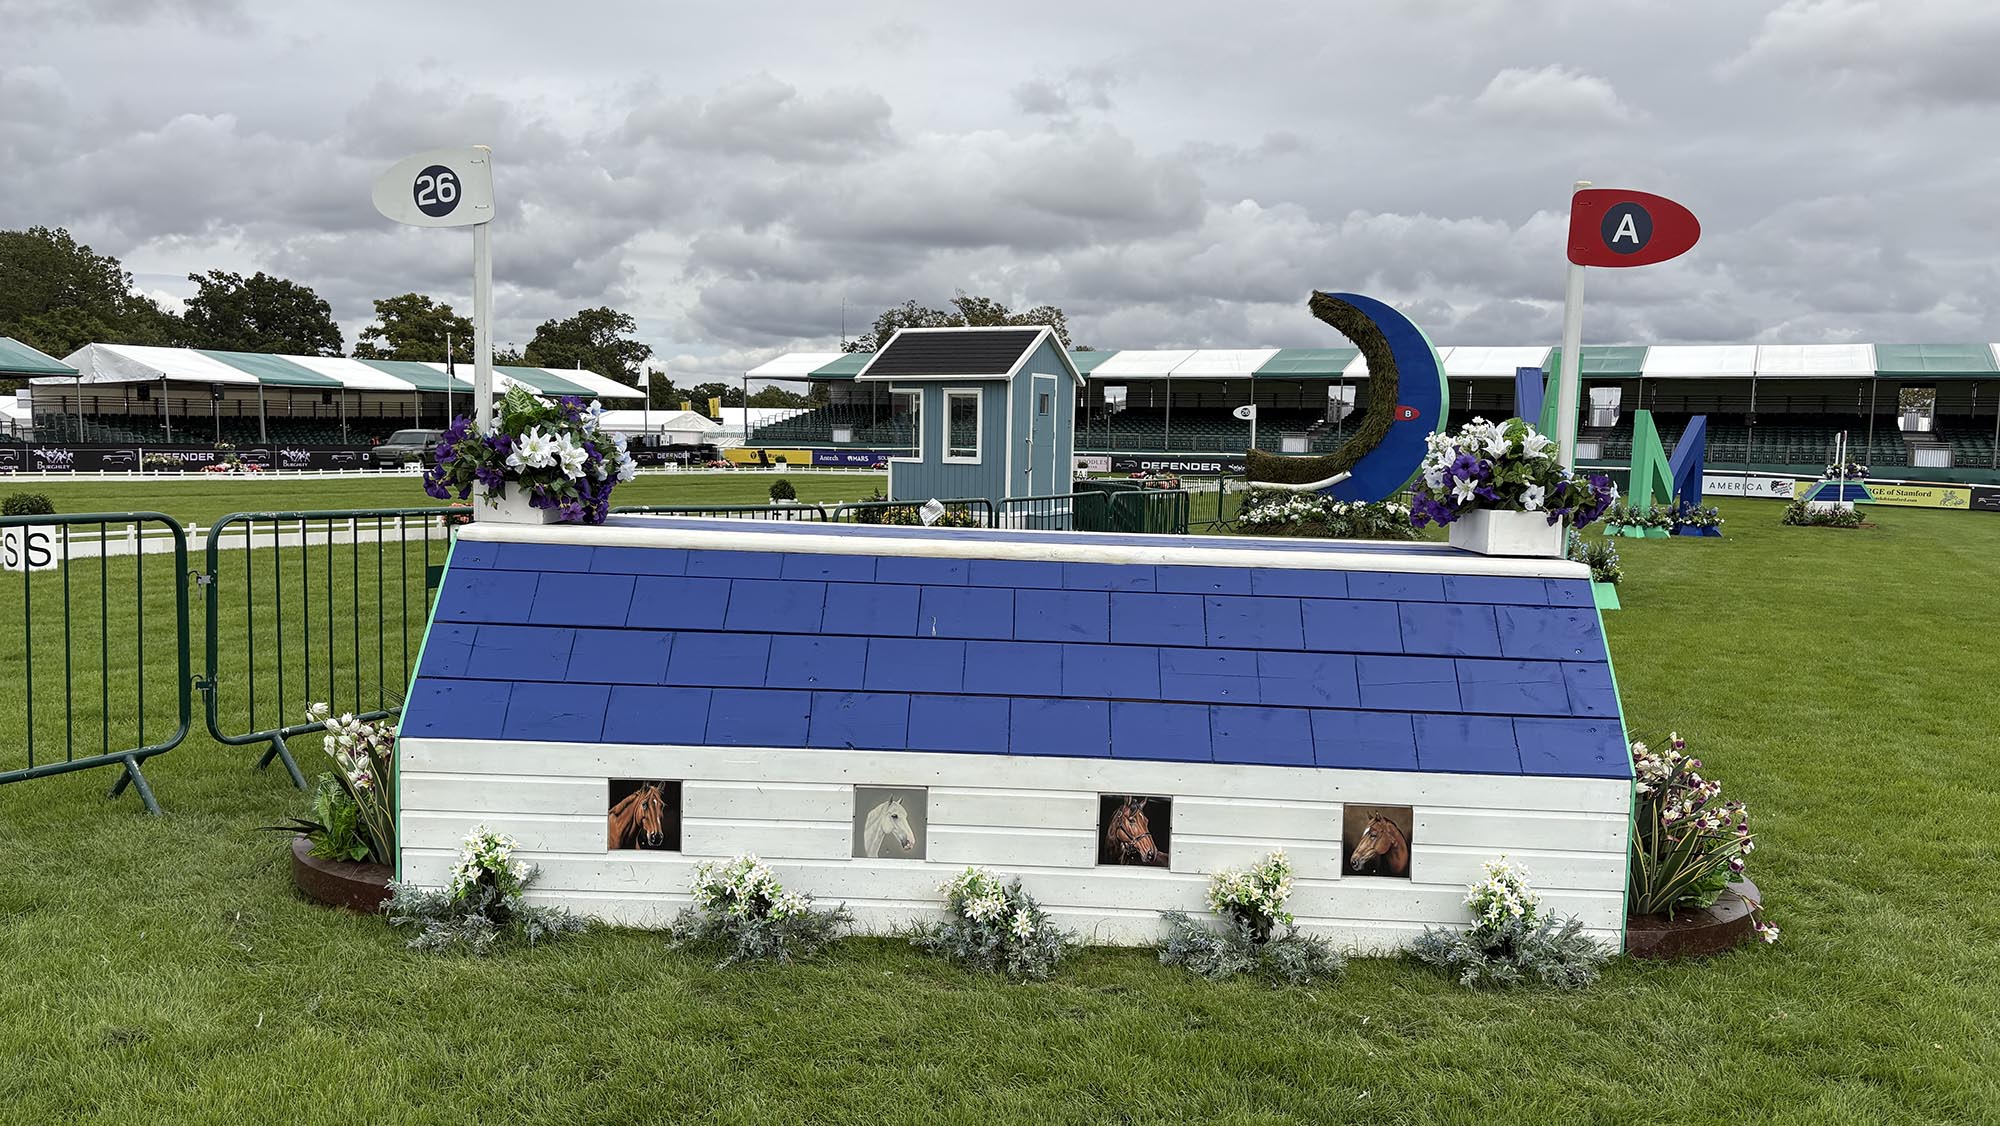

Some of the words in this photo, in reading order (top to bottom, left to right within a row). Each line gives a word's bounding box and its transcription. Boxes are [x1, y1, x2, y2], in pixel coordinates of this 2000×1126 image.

[416, 172, 456, 206] 26
[1611, 213, 1639, 244] A
[1404, 409, 1412, 418] B
[656, 452, 691, 460] DEFENDER
[1141, 461, 1222, 472] DEFENDER
[1708, 481, 1763, 491] AMERICA
[1896, 489, 1932, 498] Stamford
[5, 533, 18, 567] S
[27, 532, 52, 567] S
